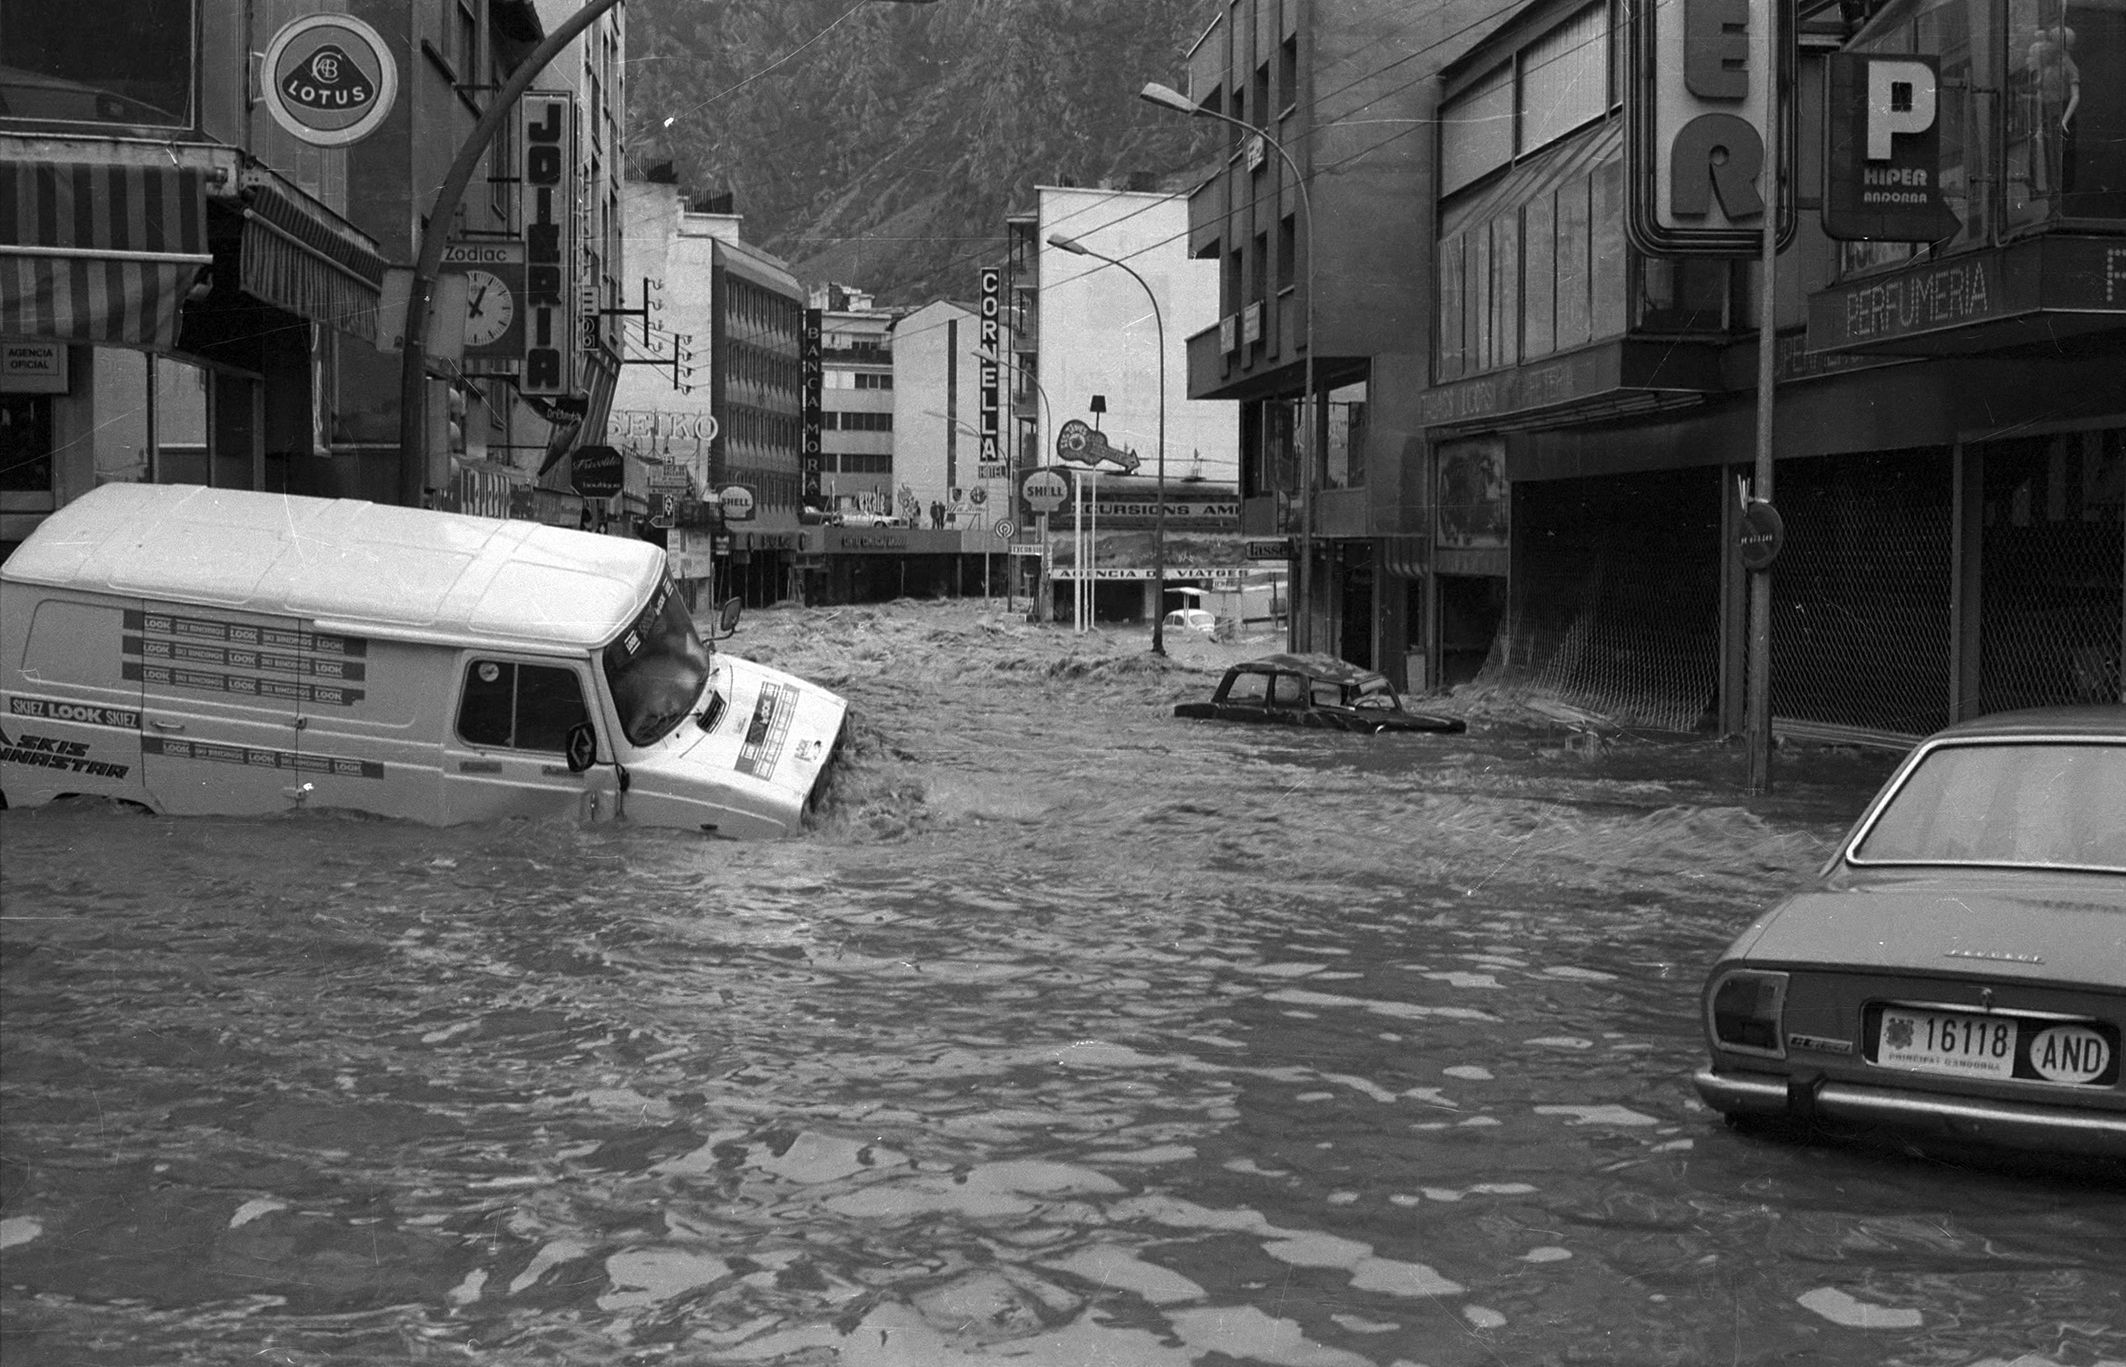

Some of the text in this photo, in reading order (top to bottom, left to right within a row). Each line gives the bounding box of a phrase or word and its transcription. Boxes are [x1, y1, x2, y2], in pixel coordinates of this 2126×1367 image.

[288, 80, 365, 105] LOTUS
[1867, 61, 1936, 160] P
[1864, 168, 1927, 186] HIPER
[1864, 192, 1927, 203] ANDORRA
[445, 246, 507, 261] Zodiac
[528, 104, 562, 388] JOIERIA
[1847, 262, 1988, 337] PERFUMERIA
[981, 272, 998, 459] CORNELLA
[607, 411, 719, 441] SEIKO
[807, 327, 820, 497] BANCA MORA
[721, 497, 749, 506] SHELL
[144, 619, 171, 629] LOOK
[230, 629, 257, 640] LOOK
[317, 640, 344, 650] LOOK
[144, 644, 169, 653] LOOK
[229, 654, 256, 664] LOOK
[315, 663, 343, 673] LOOK
[144, 670, 170, 680] LOOK
[229, 680, 256, 690] LOOK
[315, 690, 342, 700] LOOK
[13, 699, 137, 727] SKIEZ LOOK SKIEZ
[16, 734, 91, 757] SKIS
[163, 743, 190, 753] LOOK
[248, 753, 275, 765] LOOK
[335, 762, 361, 773] LOOK
[1925, 1017, 2009, 1058] 16118
[2041, 1034, 2102, 1074] AND
